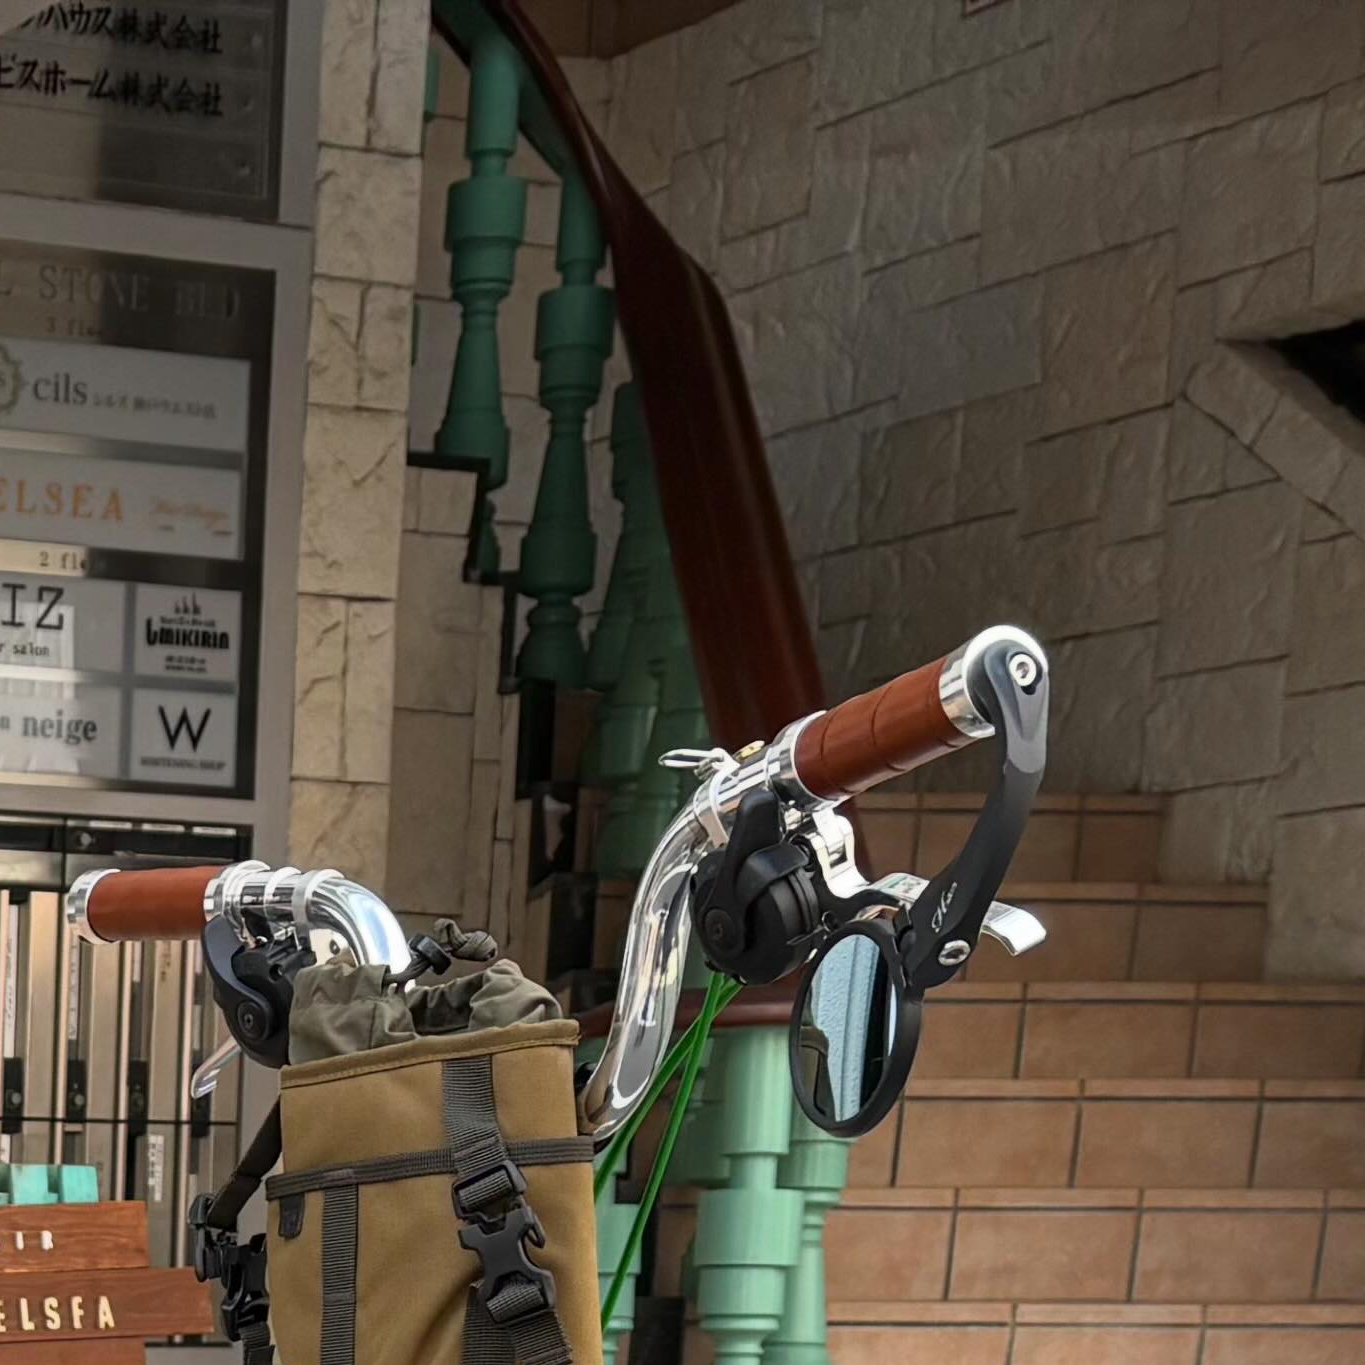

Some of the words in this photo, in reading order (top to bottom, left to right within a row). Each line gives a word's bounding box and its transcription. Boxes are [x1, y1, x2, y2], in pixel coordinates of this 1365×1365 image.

[32, 371, 88, 406] cils
[13, 640, 51, 659] salon
[21, 709, 98, 751] neige
[158, 704, 212, 752] W
